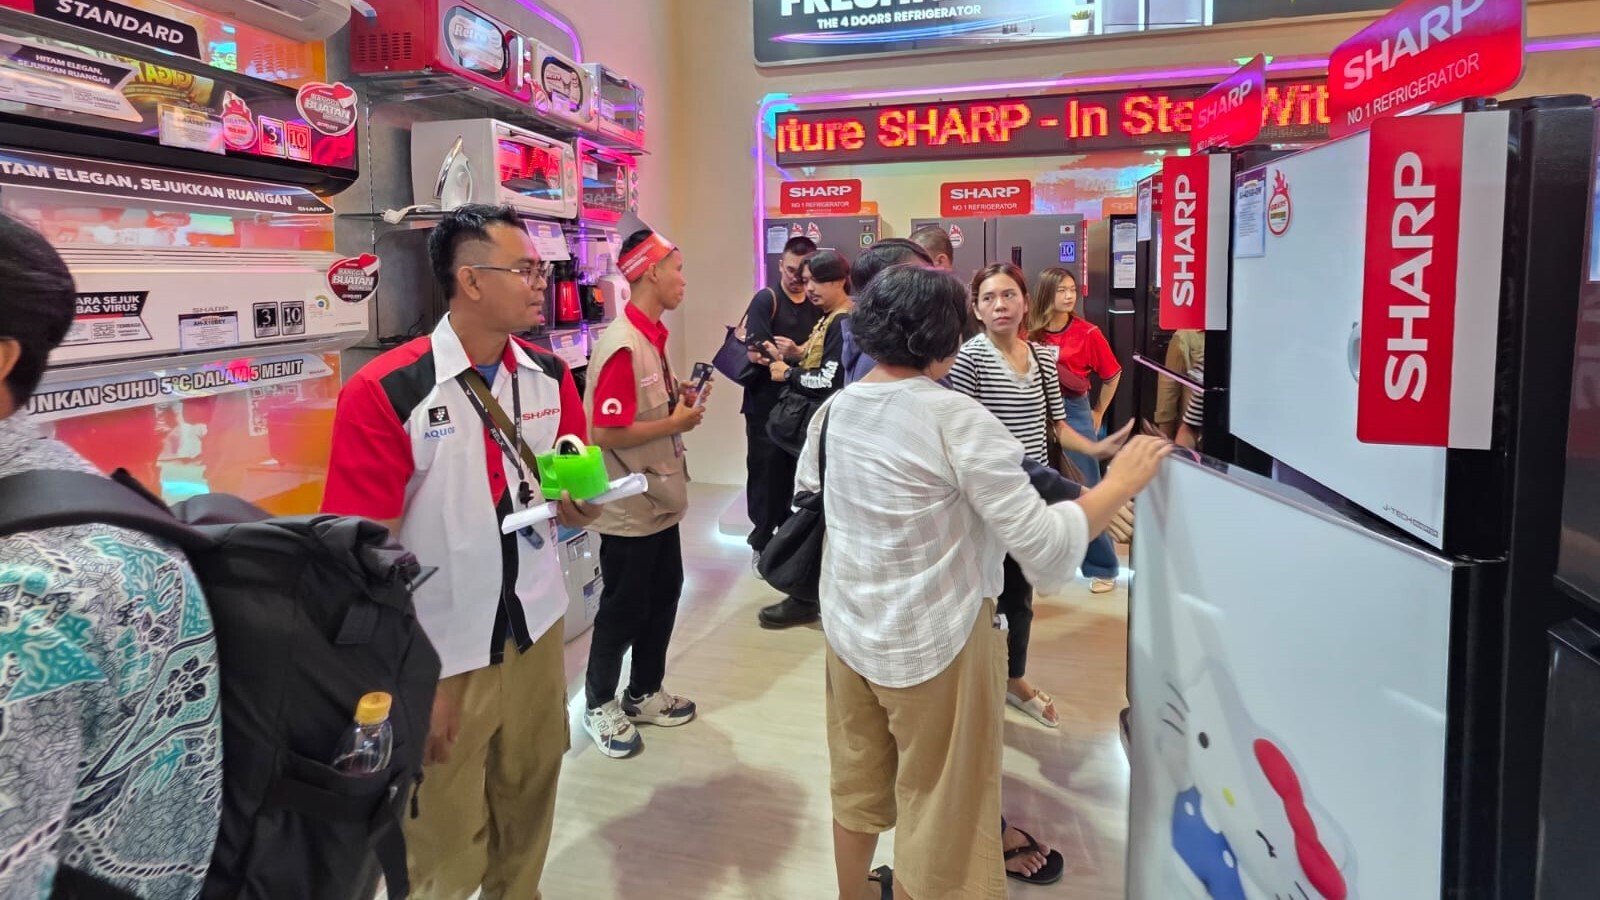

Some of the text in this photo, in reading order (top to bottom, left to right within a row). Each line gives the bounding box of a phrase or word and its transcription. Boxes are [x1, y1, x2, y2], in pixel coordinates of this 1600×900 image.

[56, 0, 184, 44] STANDARD
[817, 18, 839, 29] THE
[840, 16, 849, 27] 4
[851, 13, 891, 26] DOORS
[894, 5, 981, 22] REFRIGERATOR
[1343, 0, 1484, 90] SHARP
[35, 54, 65, 67] HITAM
[68, 69, 110, 84] RUANGAN
[1347, 53, 1479, 126] NO 1 REFRIGERATOR
[304, 99, 351, 119] BUATAN
[1198, 79, 1253, 128] SHARP
[879, 103, 1031, 147] SHARP
[1068, 100, 1108, 138] In
[1122, 95, 1193, 135] Ste
[1262, 85, 1331, 126] Wit
[266, 126, 278, 142] 3
[290, 130, 306, 148] 10
[0, 160, 292, 206] TAM ELEGAN, SEJUKKAN RUANGAN
[789, 186, 852, 197] SHARP
[950, 186, 1020, 199] SHARP
[1172, 174, 1197, 307] SHARP
[1062, 244, 1073, 257] 10
[332, 275, 375, 286] BUATAN
[1384, 150, 1437, 402] SHARP
[102, 304, 138, 312] VIRUS
[103, 295, 140, 305] SEJUK
[262, 309, 272, 325] 3
[284, 307, 301, 323] 10
[25, 386, 101, 415] UNKAN
[102, 378, 158, 403] SUHU
[193, 366, 249, 389] DALAM
[249, 365, 261, 381] 5
[261, 359, 303, 379] MENIT
